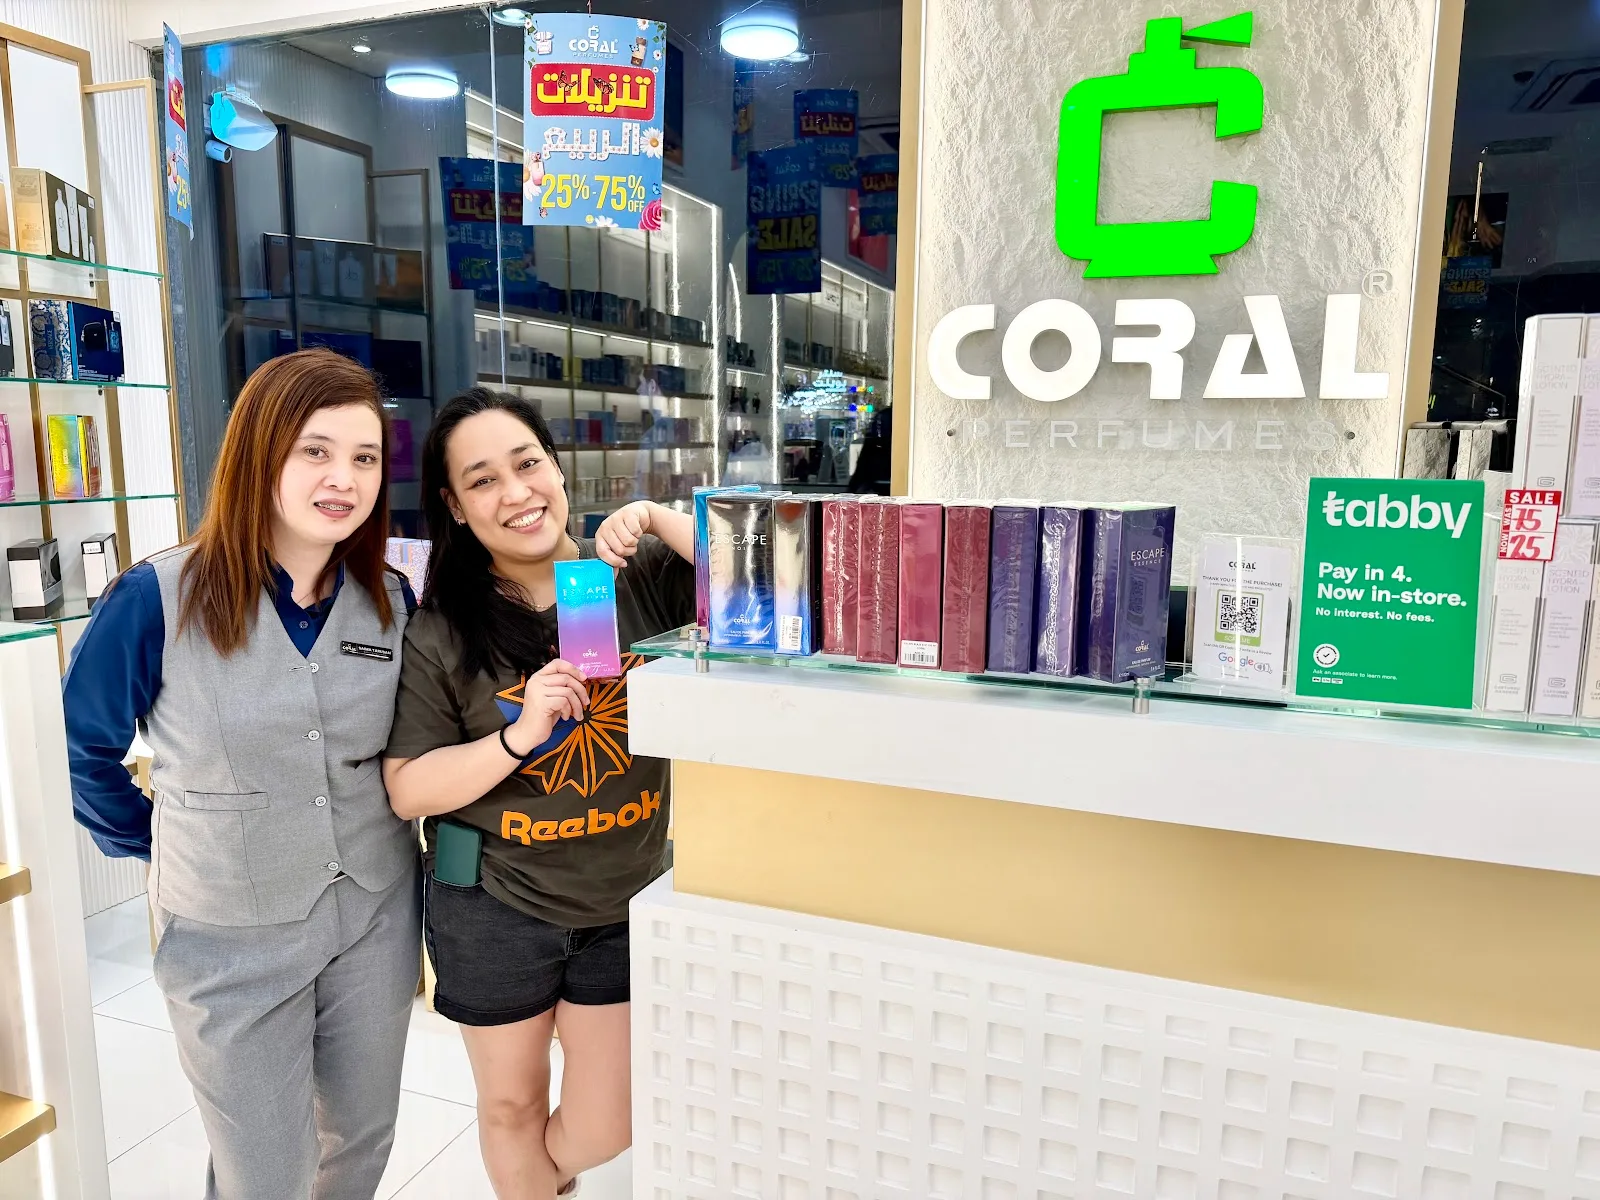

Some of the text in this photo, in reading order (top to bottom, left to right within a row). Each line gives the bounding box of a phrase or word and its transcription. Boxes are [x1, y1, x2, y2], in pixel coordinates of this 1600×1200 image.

[568, 39, 619, 53] CORAL
[536, 68, 651, 113] تنزيلات
[541, 122, 641, 161] الربيع
[627, 200, 644, 213] OFF
[927, 294, 1390, 402] CORAL
[960, 419, 1340, 452] PERFUMES
[1509, 492, 1555, 504] SALE
[1322, 491, 1472, 539] tabby
[1502, 507, 1512, 526] WAS
[715, 534, 767, 545] ESCAPE
[1500, 533, 1508, 553] NOW
[1131, 547, 1165, 561] ESCAPE
[1318, 562, 1412, 584] Pay in 4.
[1317, 583, 1467, 607] Now in-store.
[1315, 607, 1435, 622] No interest. No fees.
[1218, 652, 1254, 667] Gogle
[501, 789, 660, 846] Reebok
